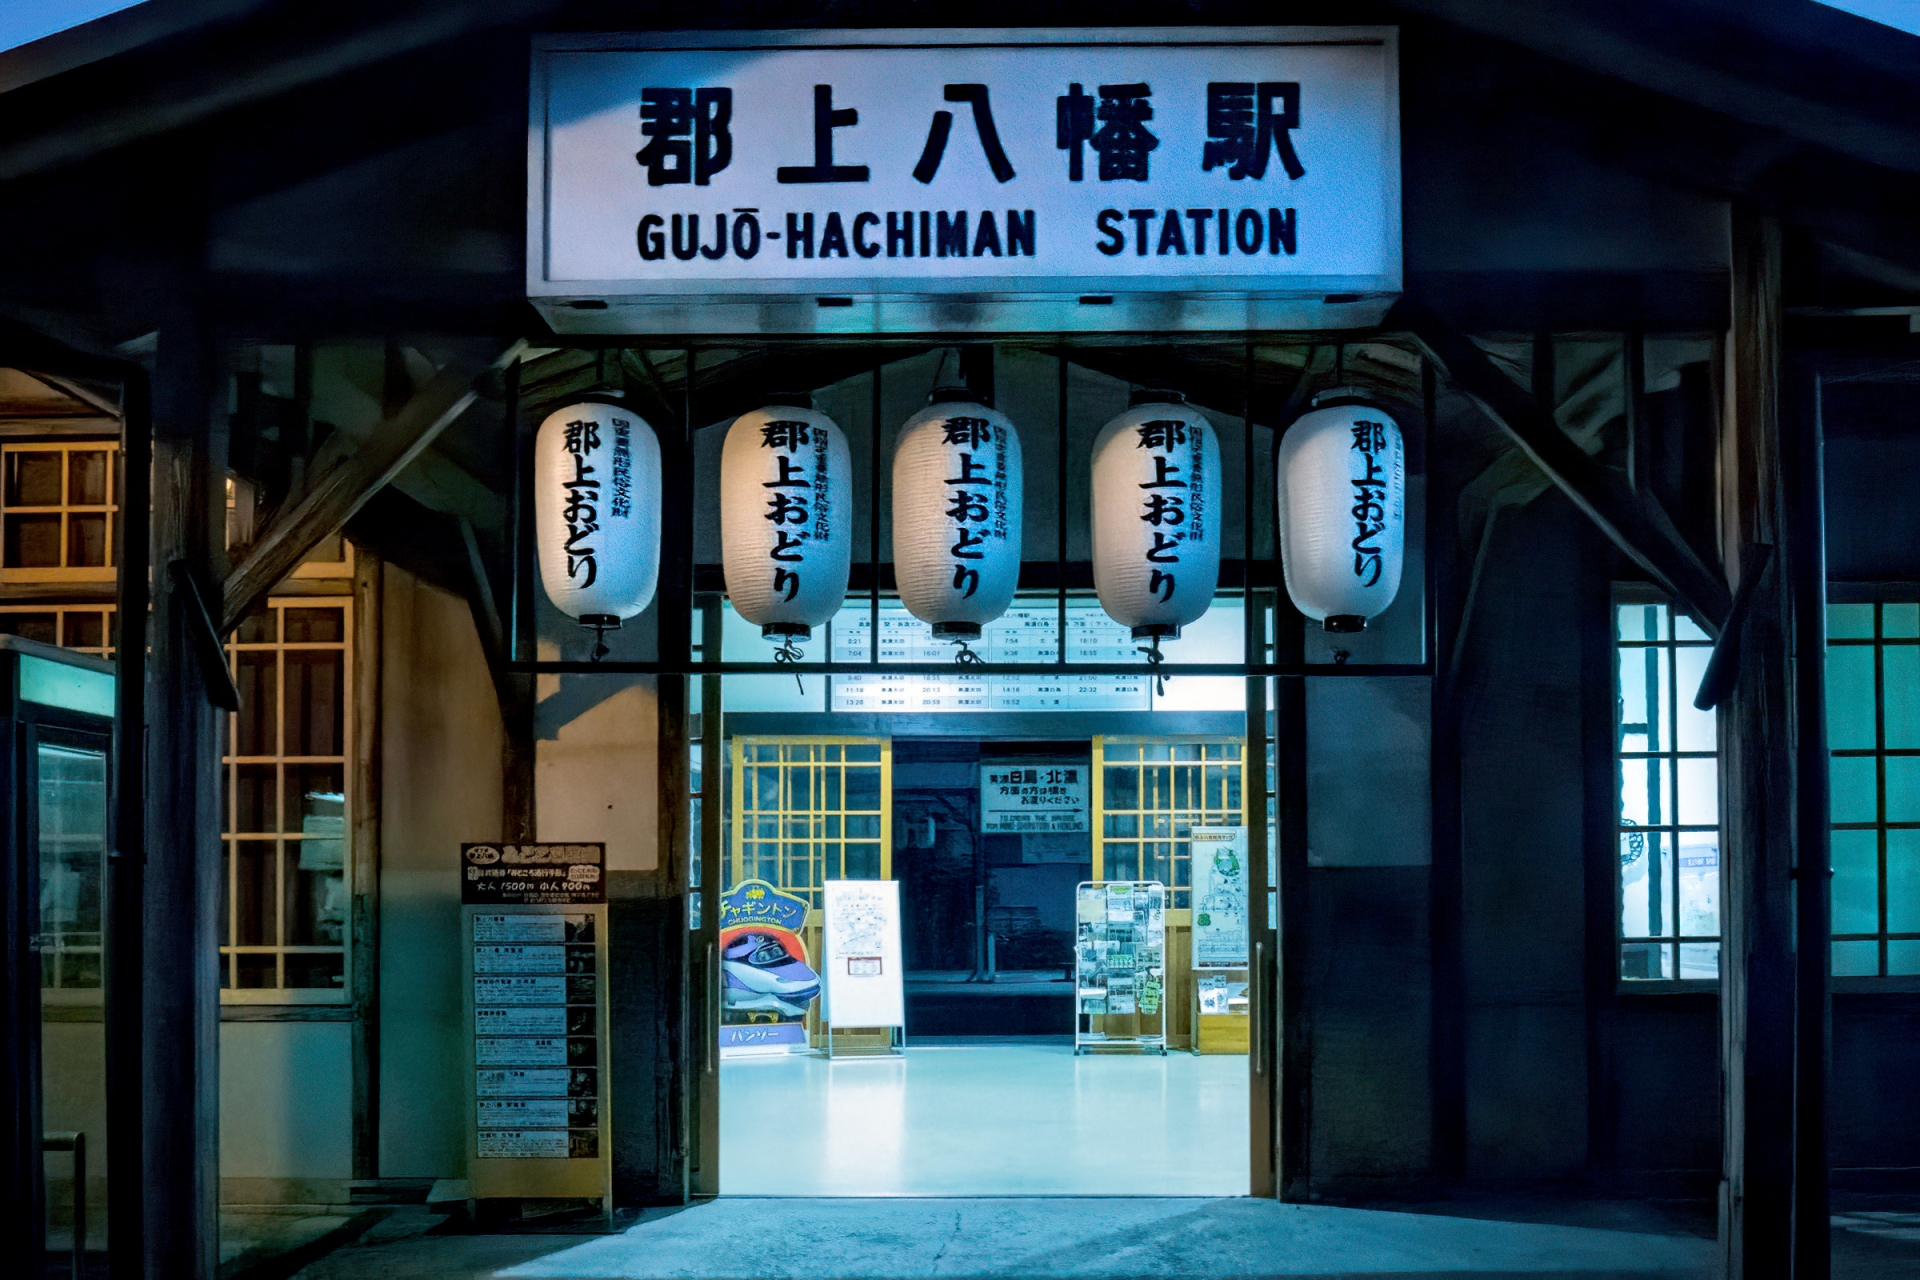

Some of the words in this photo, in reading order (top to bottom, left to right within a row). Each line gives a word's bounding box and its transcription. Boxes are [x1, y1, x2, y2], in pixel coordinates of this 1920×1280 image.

[636, 82, 1305, 187] 郡上八幡駅
[638, 207, 1035, 261] GUJŌ-HACHIMAN
[1096, 207, 1297, 257] STATION
[562, 419, 601, 589] 郡上おどり
[760, 419, 812, 603] 郡上おどり
[942, 416, 992, 600] 郡上おどり
[1137, 419, 1188, 604] 郡上おどり
[1351, 419, 1387, 588] 郡上おどり
[720, 900, 797, 919] チャギントン
